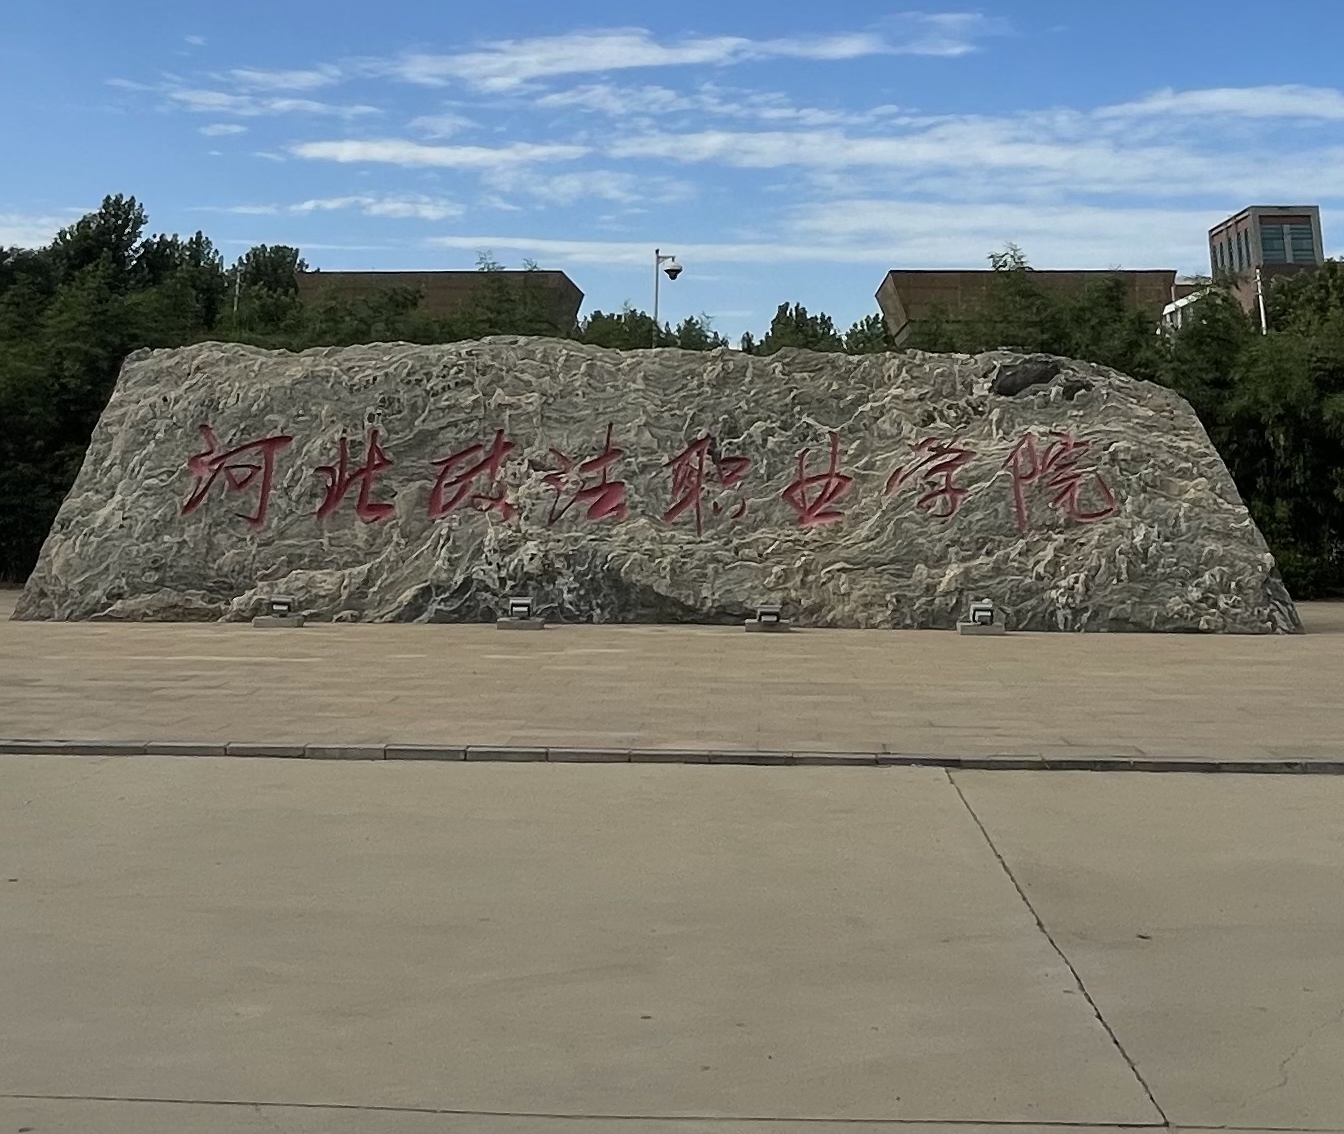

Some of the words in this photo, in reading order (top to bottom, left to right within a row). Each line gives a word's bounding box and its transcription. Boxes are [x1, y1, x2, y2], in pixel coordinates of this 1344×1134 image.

[181, 423, 1120, 537] 河北政法职业学院
